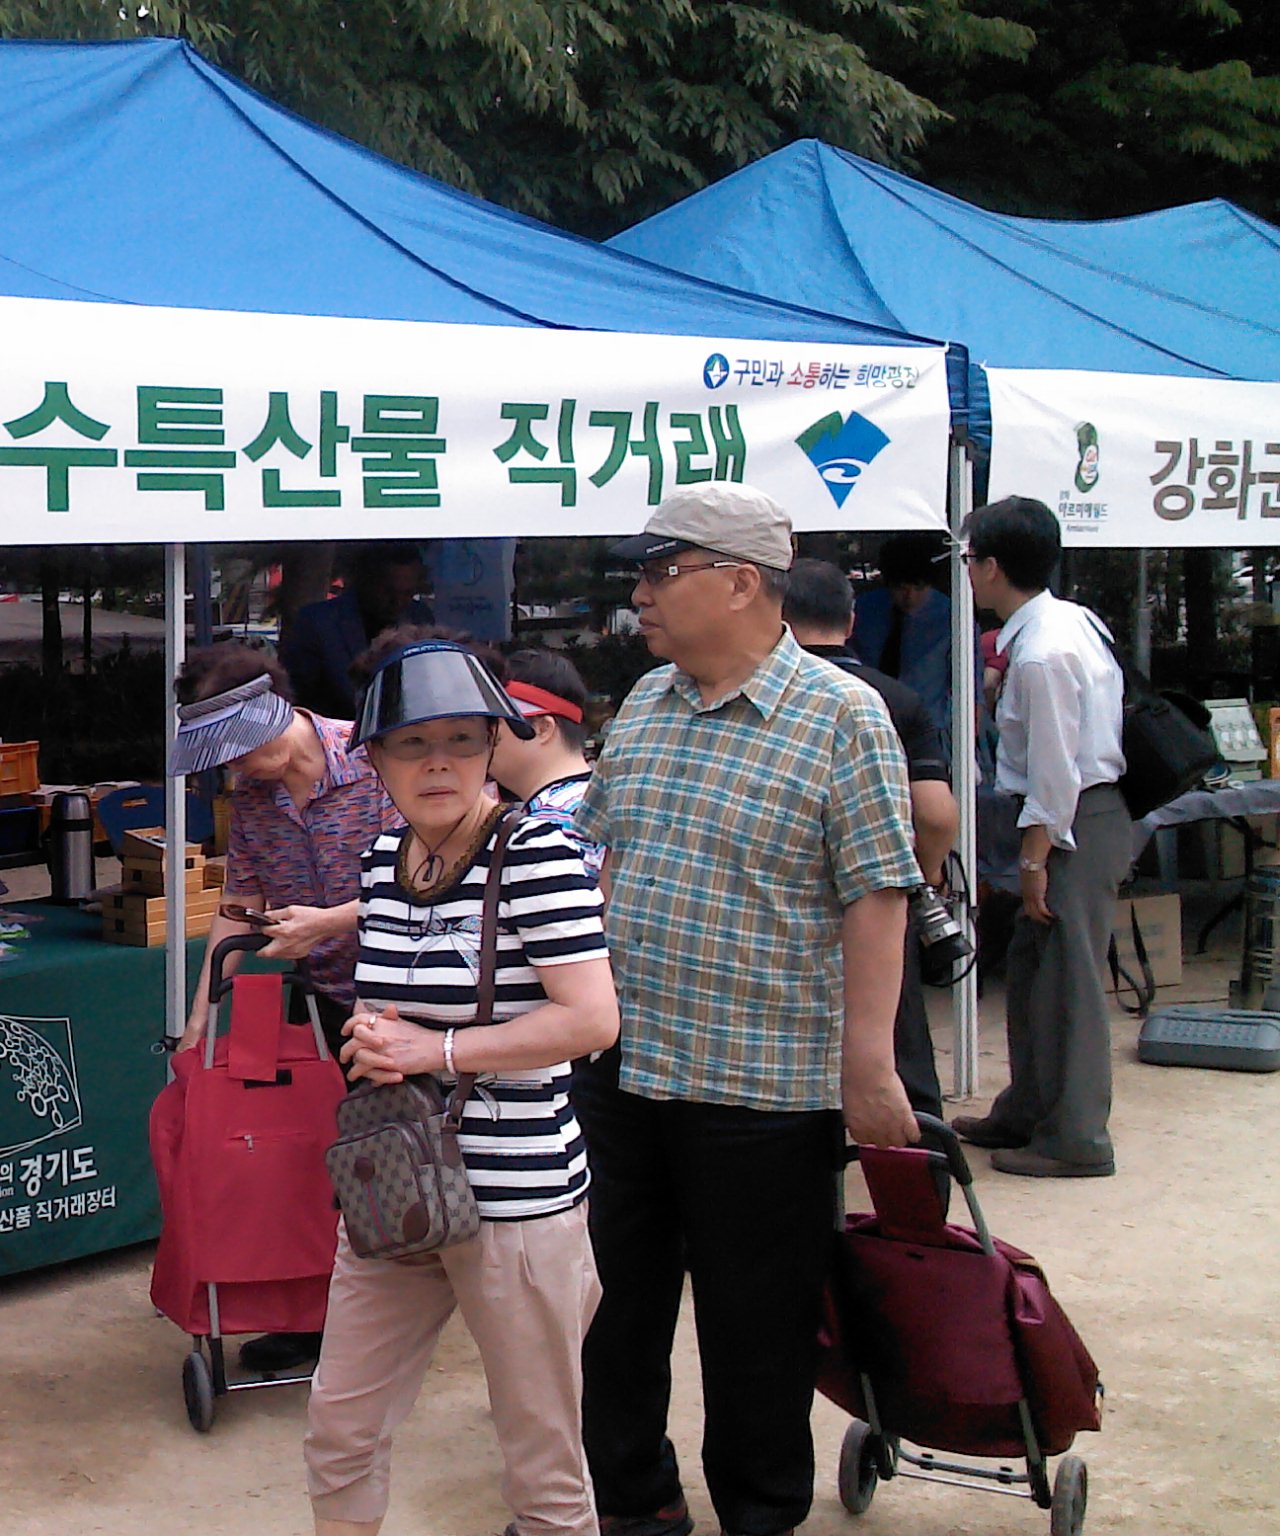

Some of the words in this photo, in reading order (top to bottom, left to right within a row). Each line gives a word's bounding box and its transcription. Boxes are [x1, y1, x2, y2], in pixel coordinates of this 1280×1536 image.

[734, 359, 784, 387] 구민과
[787, 362, 851, 389] 소통하는
[493, 399, 747, 507] 직거래
[19, 1146, 98, 1198] 경기도
[35, 1186, 116, 1224] 직거래장터
